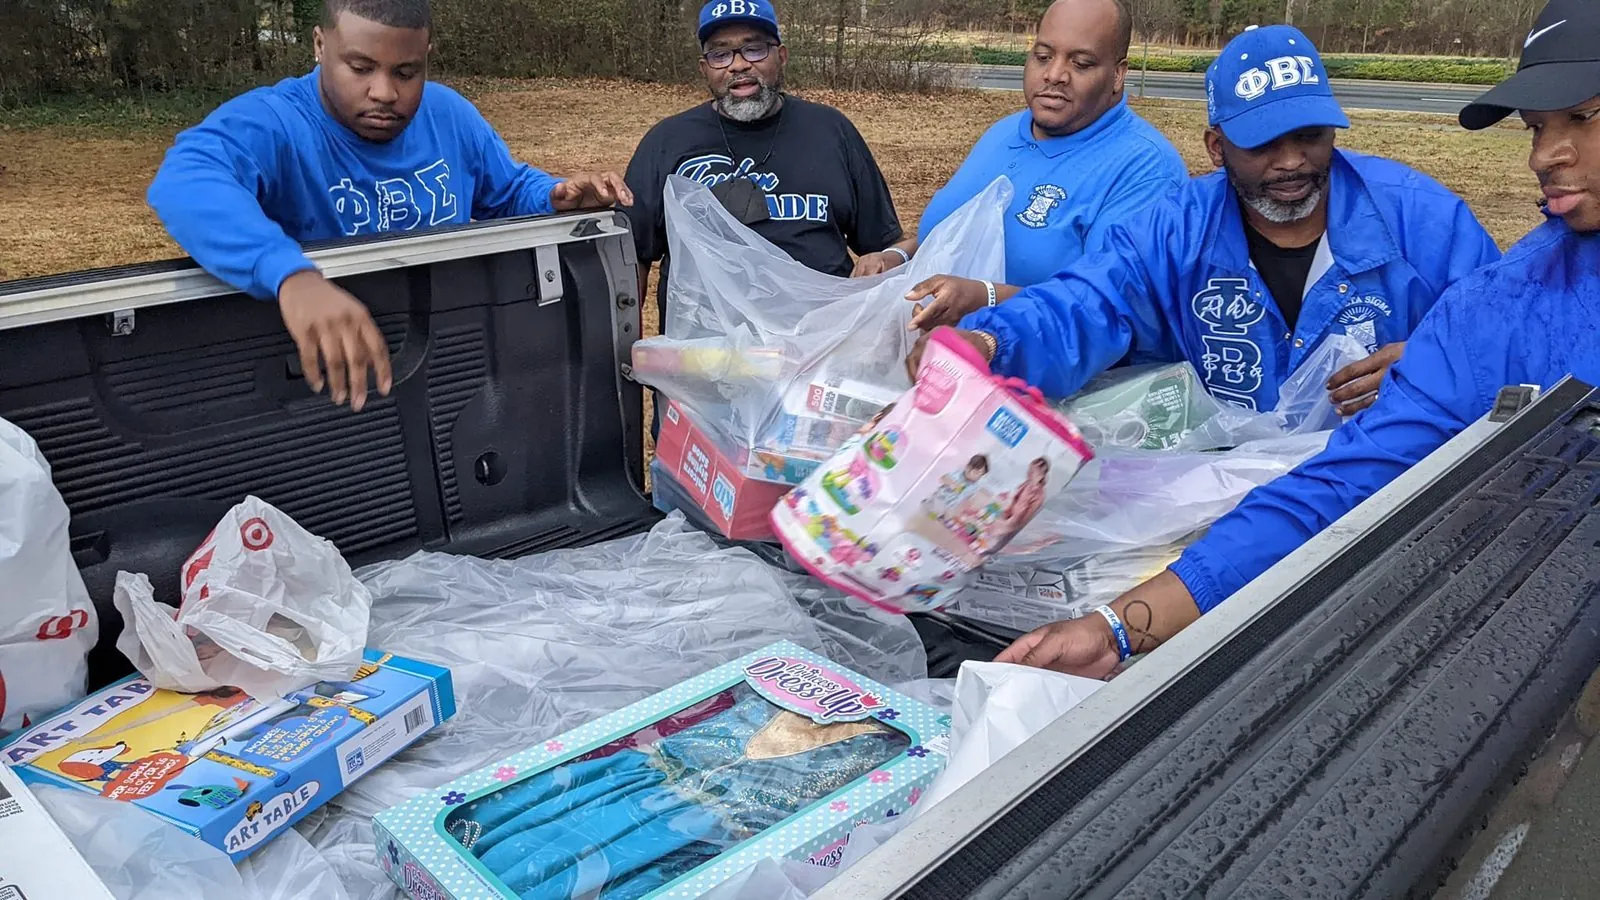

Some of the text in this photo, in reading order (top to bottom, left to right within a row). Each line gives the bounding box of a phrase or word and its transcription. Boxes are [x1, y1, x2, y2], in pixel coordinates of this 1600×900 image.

[1234, 56, 1319, 101] ΦΒΣ
[328, 158, 457, 236] ΦΒΣ
[380, 186, 391, 231] 1914
[764, 193, 829, 222] ADE
[1364, 295, 1393, 317] SIGMA
[1117, 629, 1127, 649] Sigma
[745, 657, 864, 719] Dress Up
[787, 664, 840, 694] Princess
[7, 682, 153, 763] ART TAB
[135, 767, 160, 786] OVER
[229, 785, 310, 851] ART TABLE
